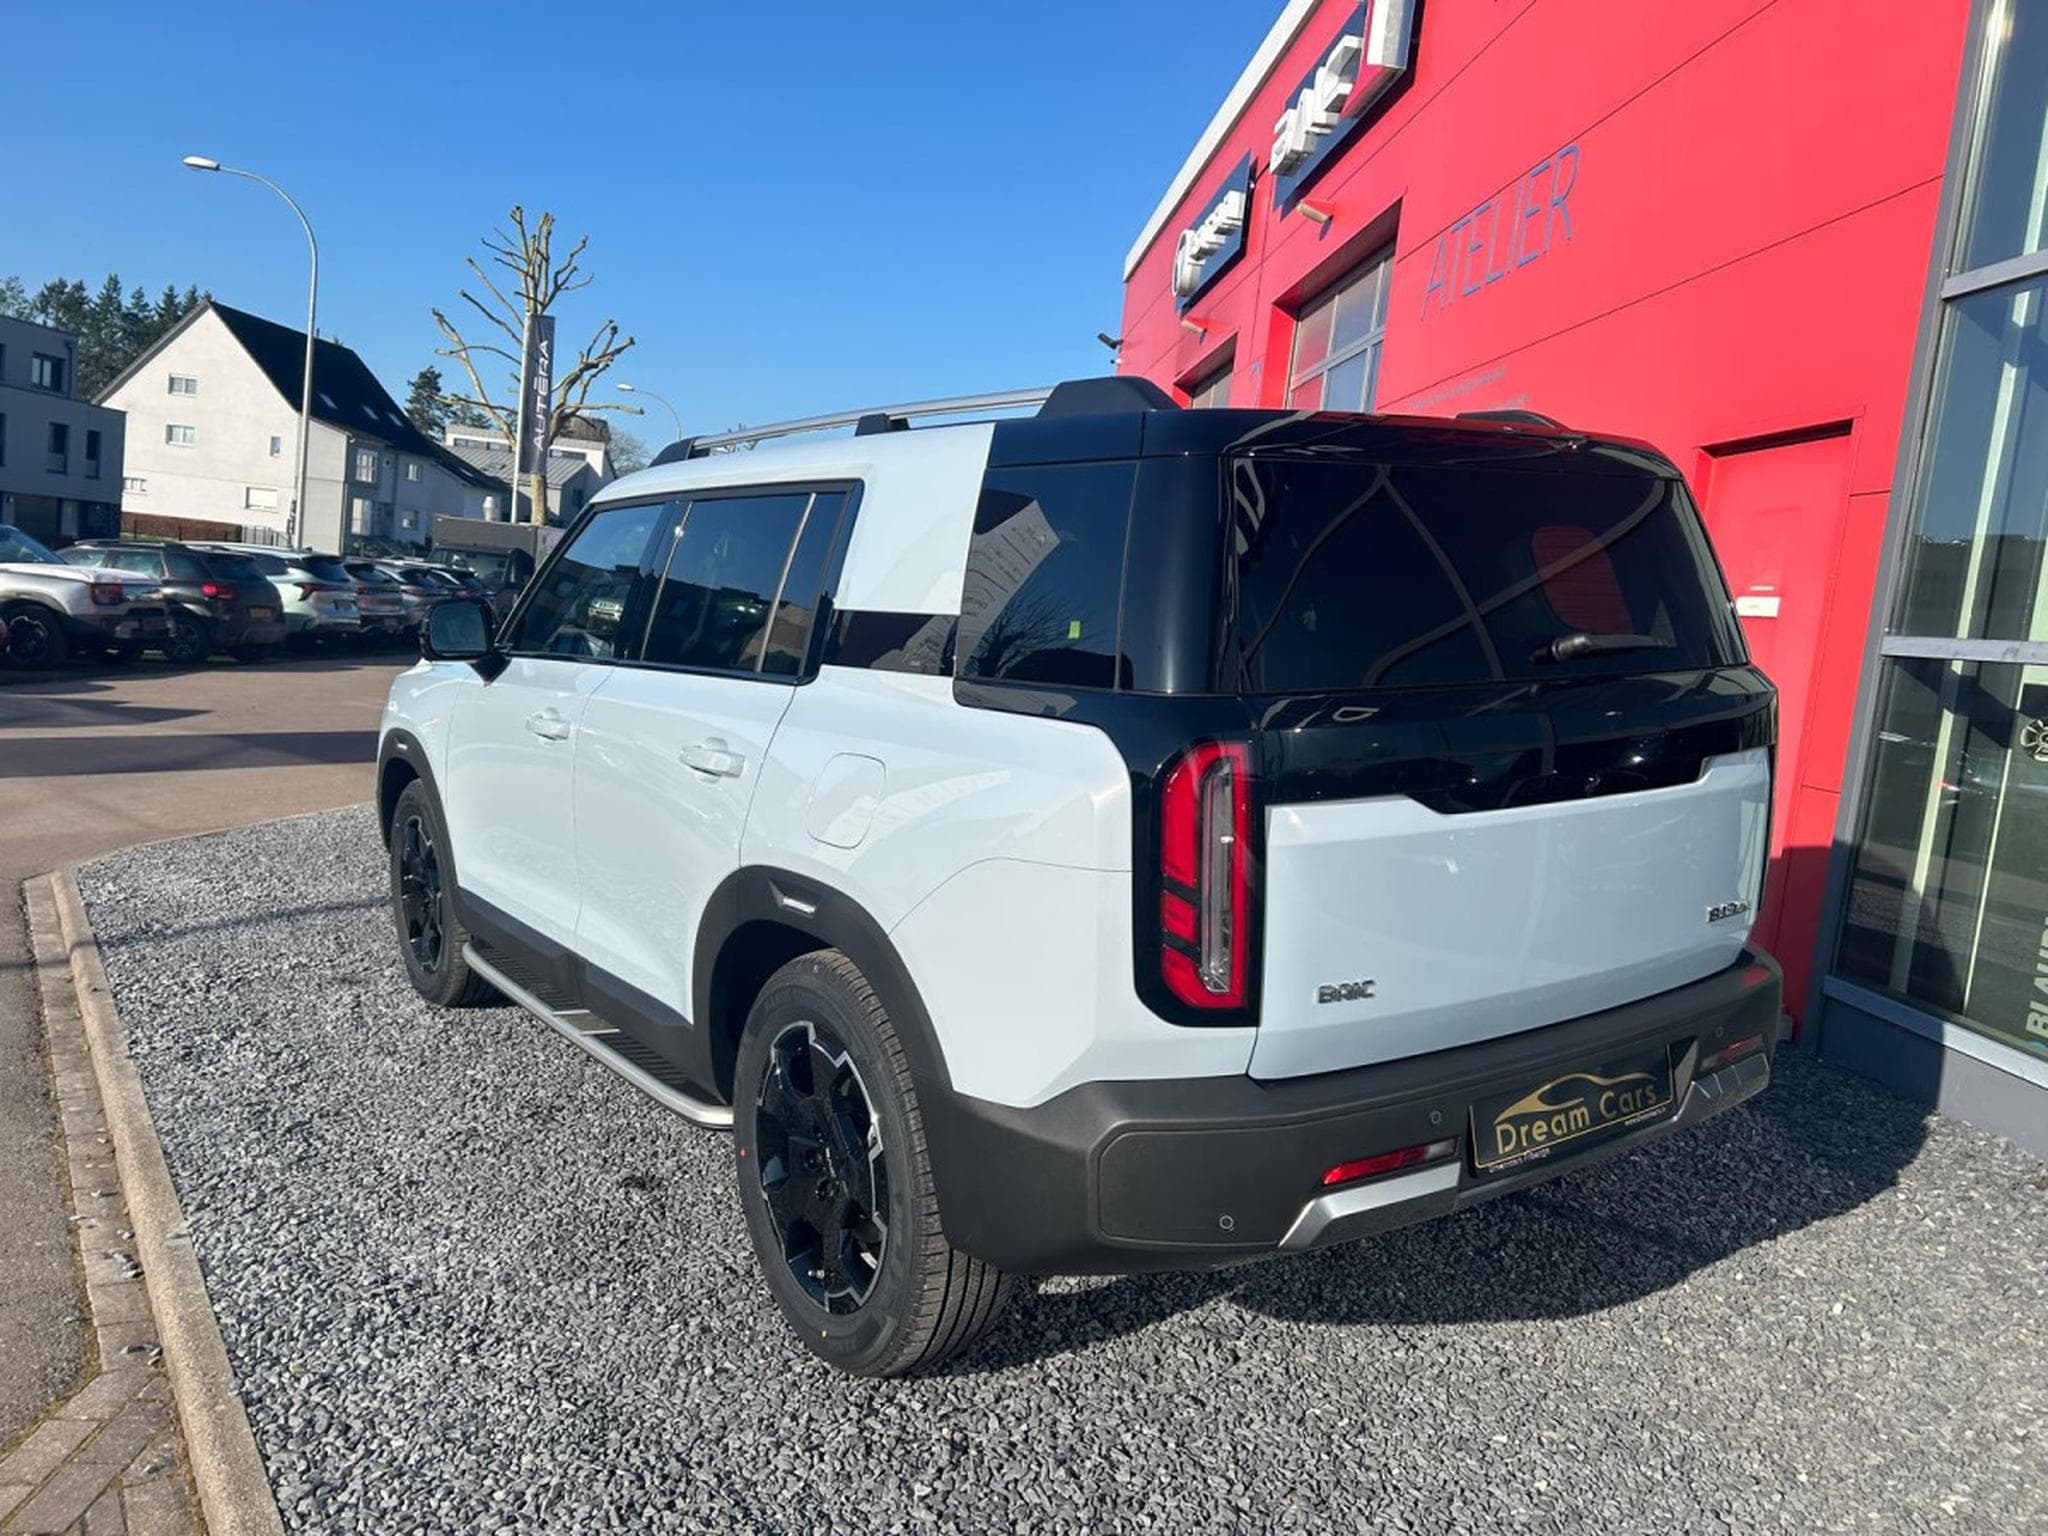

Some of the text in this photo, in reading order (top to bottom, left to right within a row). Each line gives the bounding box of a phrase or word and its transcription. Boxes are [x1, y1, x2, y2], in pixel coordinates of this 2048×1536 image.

[1421, 145, 1579, 321] ATELIER
[1496, 1106, 1590, 1154] Dream
[1600, 1084, 1657, 1119] Cars
